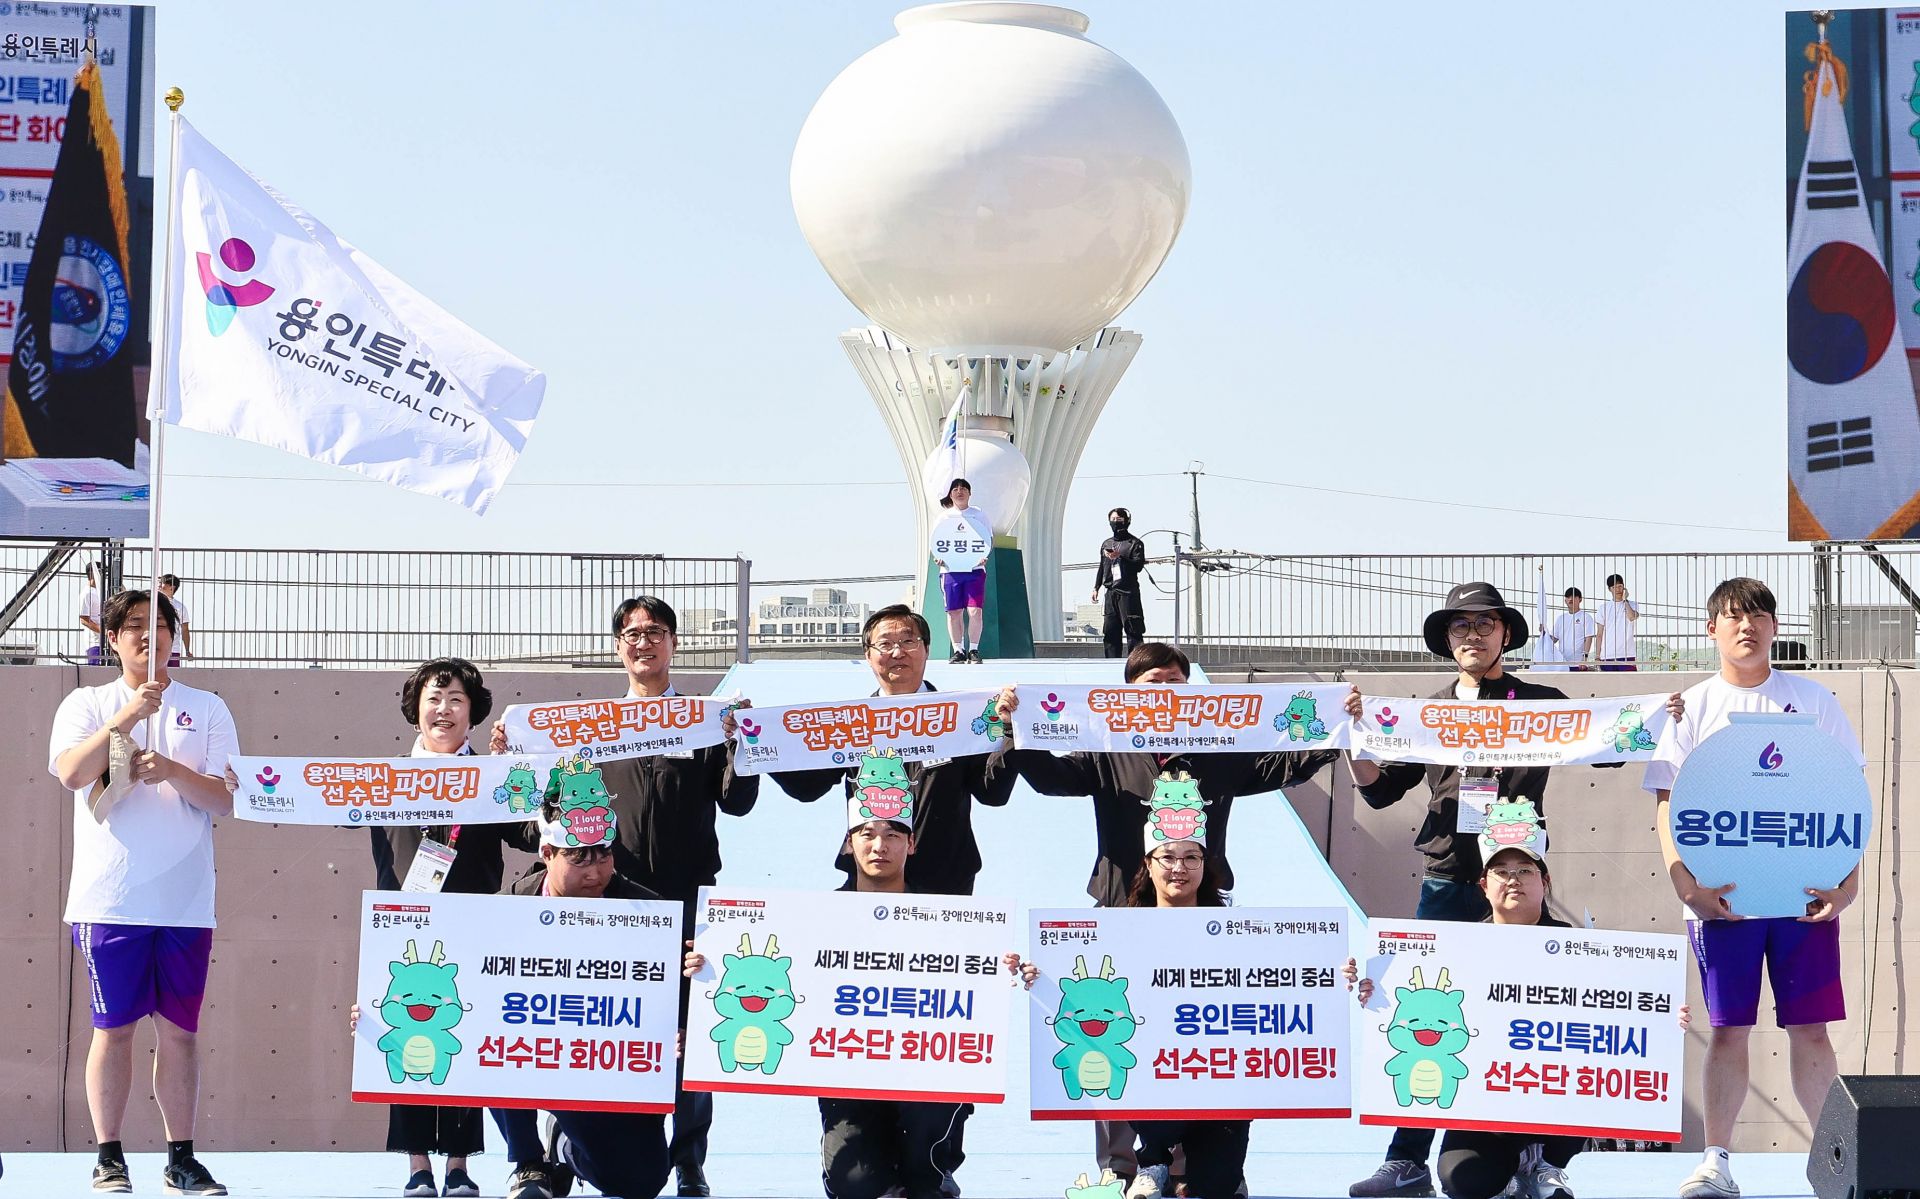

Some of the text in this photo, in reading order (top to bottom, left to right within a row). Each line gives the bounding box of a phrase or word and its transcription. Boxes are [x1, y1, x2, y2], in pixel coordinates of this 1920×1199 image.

[2, 33, 98, 59] 용인특례시
[0, 77, 67, 105] 인특례
[276, 298, 455, 397] 용인특례
[266, 337, 476, 433] YONGIN SPECIAL CITY
[936, 539, 985, 554] 양평군
[764, 602, 858, 619] RICHENSIA
[1090, 692, 1172, 710] 용인특례시
[532, 703, 614, 726] 용인특례시
[620, 698, 701, 729] 파이팅!
[787, 706, 867, 729] 용인특례시
[874, 704, 954, 735] 파이팅!
[1110, 711, 1172, 728] 선수단
[1177, 698, 1259, 726] 파이팅!
[1423, 708, 1502, 726] 용인특례시
[554, 722, 616, 742] 선수단
[807, 726, 869, 747] 선수단
[1032, 722, 1078, 735] 용인특례시
[1441, 728, 1503, 746] 선수단
[1507, 712, 1586, 742] 파이팅!
[595, 736, 683, 757] 용인특례시장애인체육회
[1148, 736, 1235, 747] 용인특례시장애인체육회
[1365, 734, 1411, 749] 용인특례시
[745, 746, 778, 758] 인특례시
[307, 765, 389, 785] 용인특례시
[393, 769, 478, 799] 파이팅!
[249, 794, 294, 807] 용인특례시
[326, 784, 389, 803] 선수단
[878, 793, 898, 801] love
[365, 809, 453, 820] 용인특례시장애인체육회
[870, 801, 890, 809] Yong
[575, 815, 601, 824] I love
[1675, 810, 1862, 849] 용인특례시
[372, 913, 430, 929] 용인 르네상스
[559, 910, 673, 928] 용인특례시 장애인체육회
[707, 908, 765, 923] 용인 르네상스
[893, 906, 1006, 924] 용인특례시 장애인체육회
[1040, 930, 1097, 945] 용인 르네상스
[1226, 920, 1339, 935] 용인특례시 장애인체육회
[1378, 940, 1435, 956] 용인 르네상스
[1564, 941, 1678, 961] 용인특례시 장애인체육회
[482, 956, 665, 982] 세계 반도체 산업의 중심
[815, 950, 998, 976] 세계 반도체 산업의 중심
[1152, 968, 1335, 988] 세계 반도체 산업의 중심
[834, 984, 974, 1020] 용인특례시
[1487, 983, 1671, 1013] 세계 반도체 산업의 중심
[502, 992, 641, 1028] 용인특례시
[1174, 1004, 1313, 1036] 용인특례시
[809, 1027, 994, 1064] 선수단 화이팅!
[1508, 1019, 1647, 1057] 용인특례시
[478, 1036, 662, 1073] 선수단 화이팅!
[1153, 1048, 1336, 1080] 선수단 화이팅!
[1484, 1061, 1668, 1102] 선수단 화이팅!
